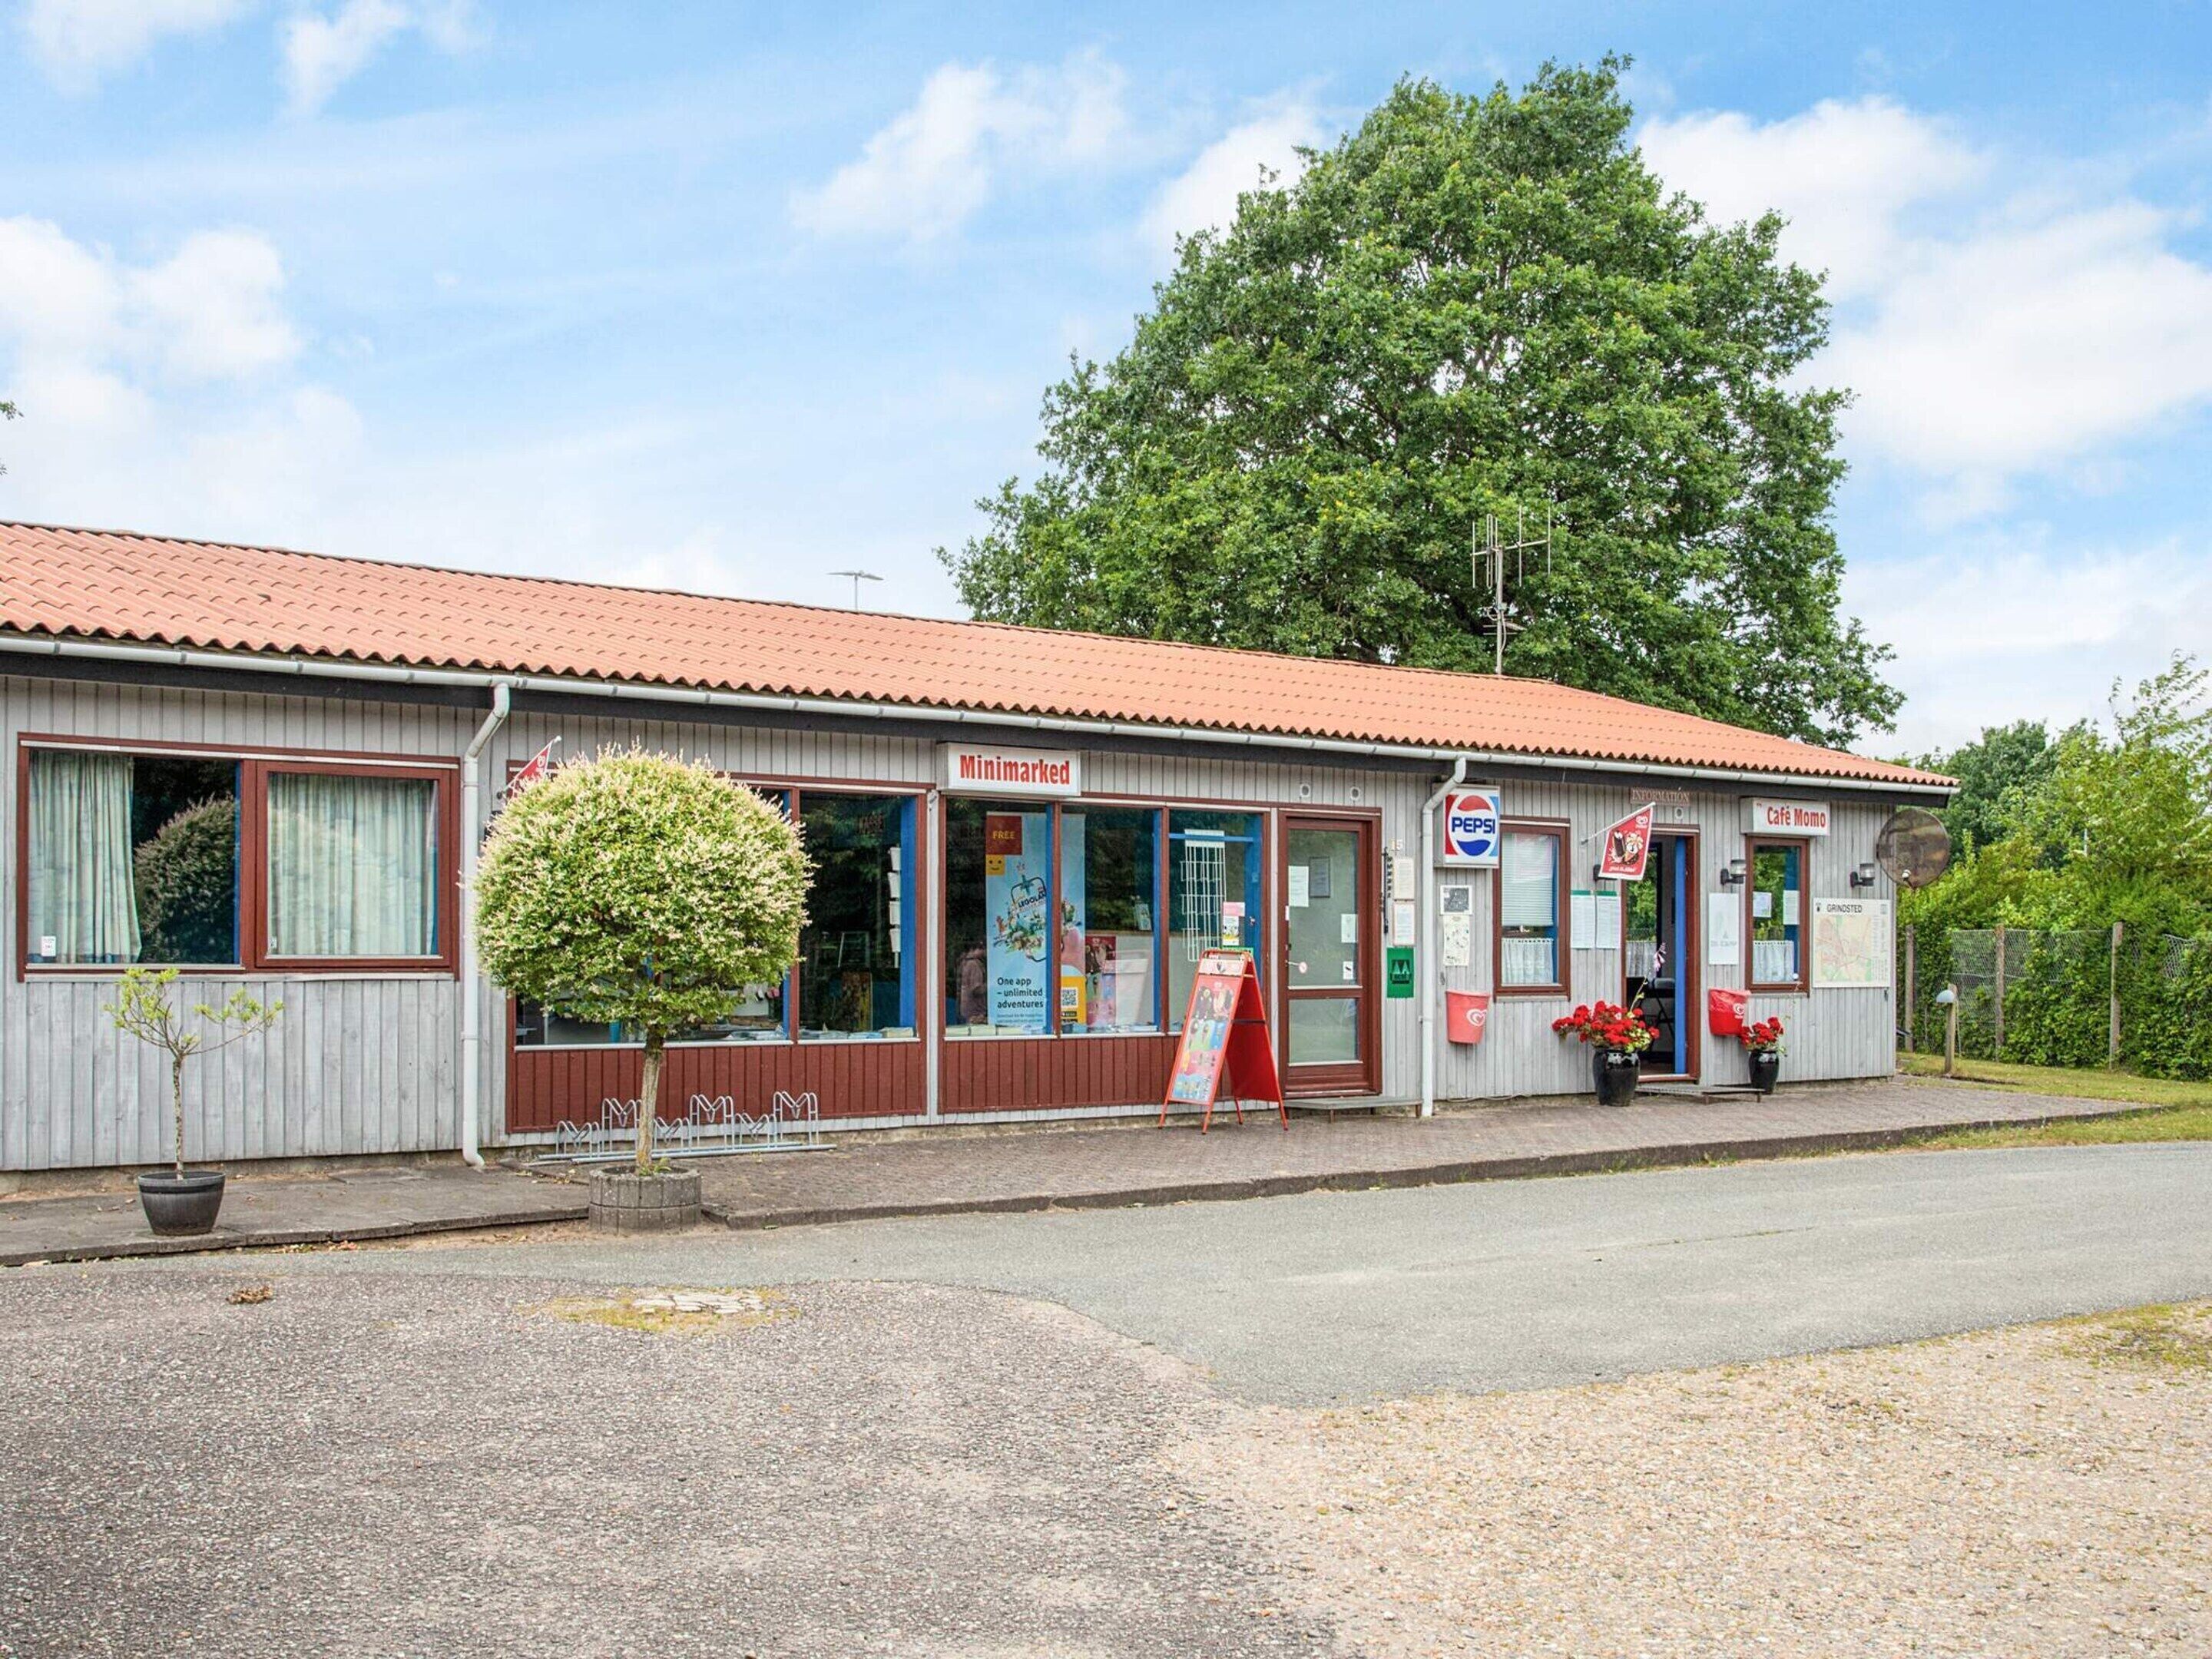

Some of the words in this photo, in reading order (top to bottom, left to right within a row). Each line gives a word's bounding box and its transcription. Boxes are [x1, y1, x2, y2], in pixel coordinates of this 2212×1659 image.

[960, 755, 1070, 784] Minimarked
[1632, 788, 1690, 803] INFORMATION
[1767, 805, 1790, 826] Café
[1794, 807, 1826, 827] Momo
[1452, 816, 1495, 834] PEPSI
[993, 830, 1015, 839] FREE
[1018, 891, 1046, 908] LEGOLAN
[1827, 904, 1863, 912] GRINDSTED
[998, 977, 1014, 985] One
[1004, 988, 1043, 996] unlimited
